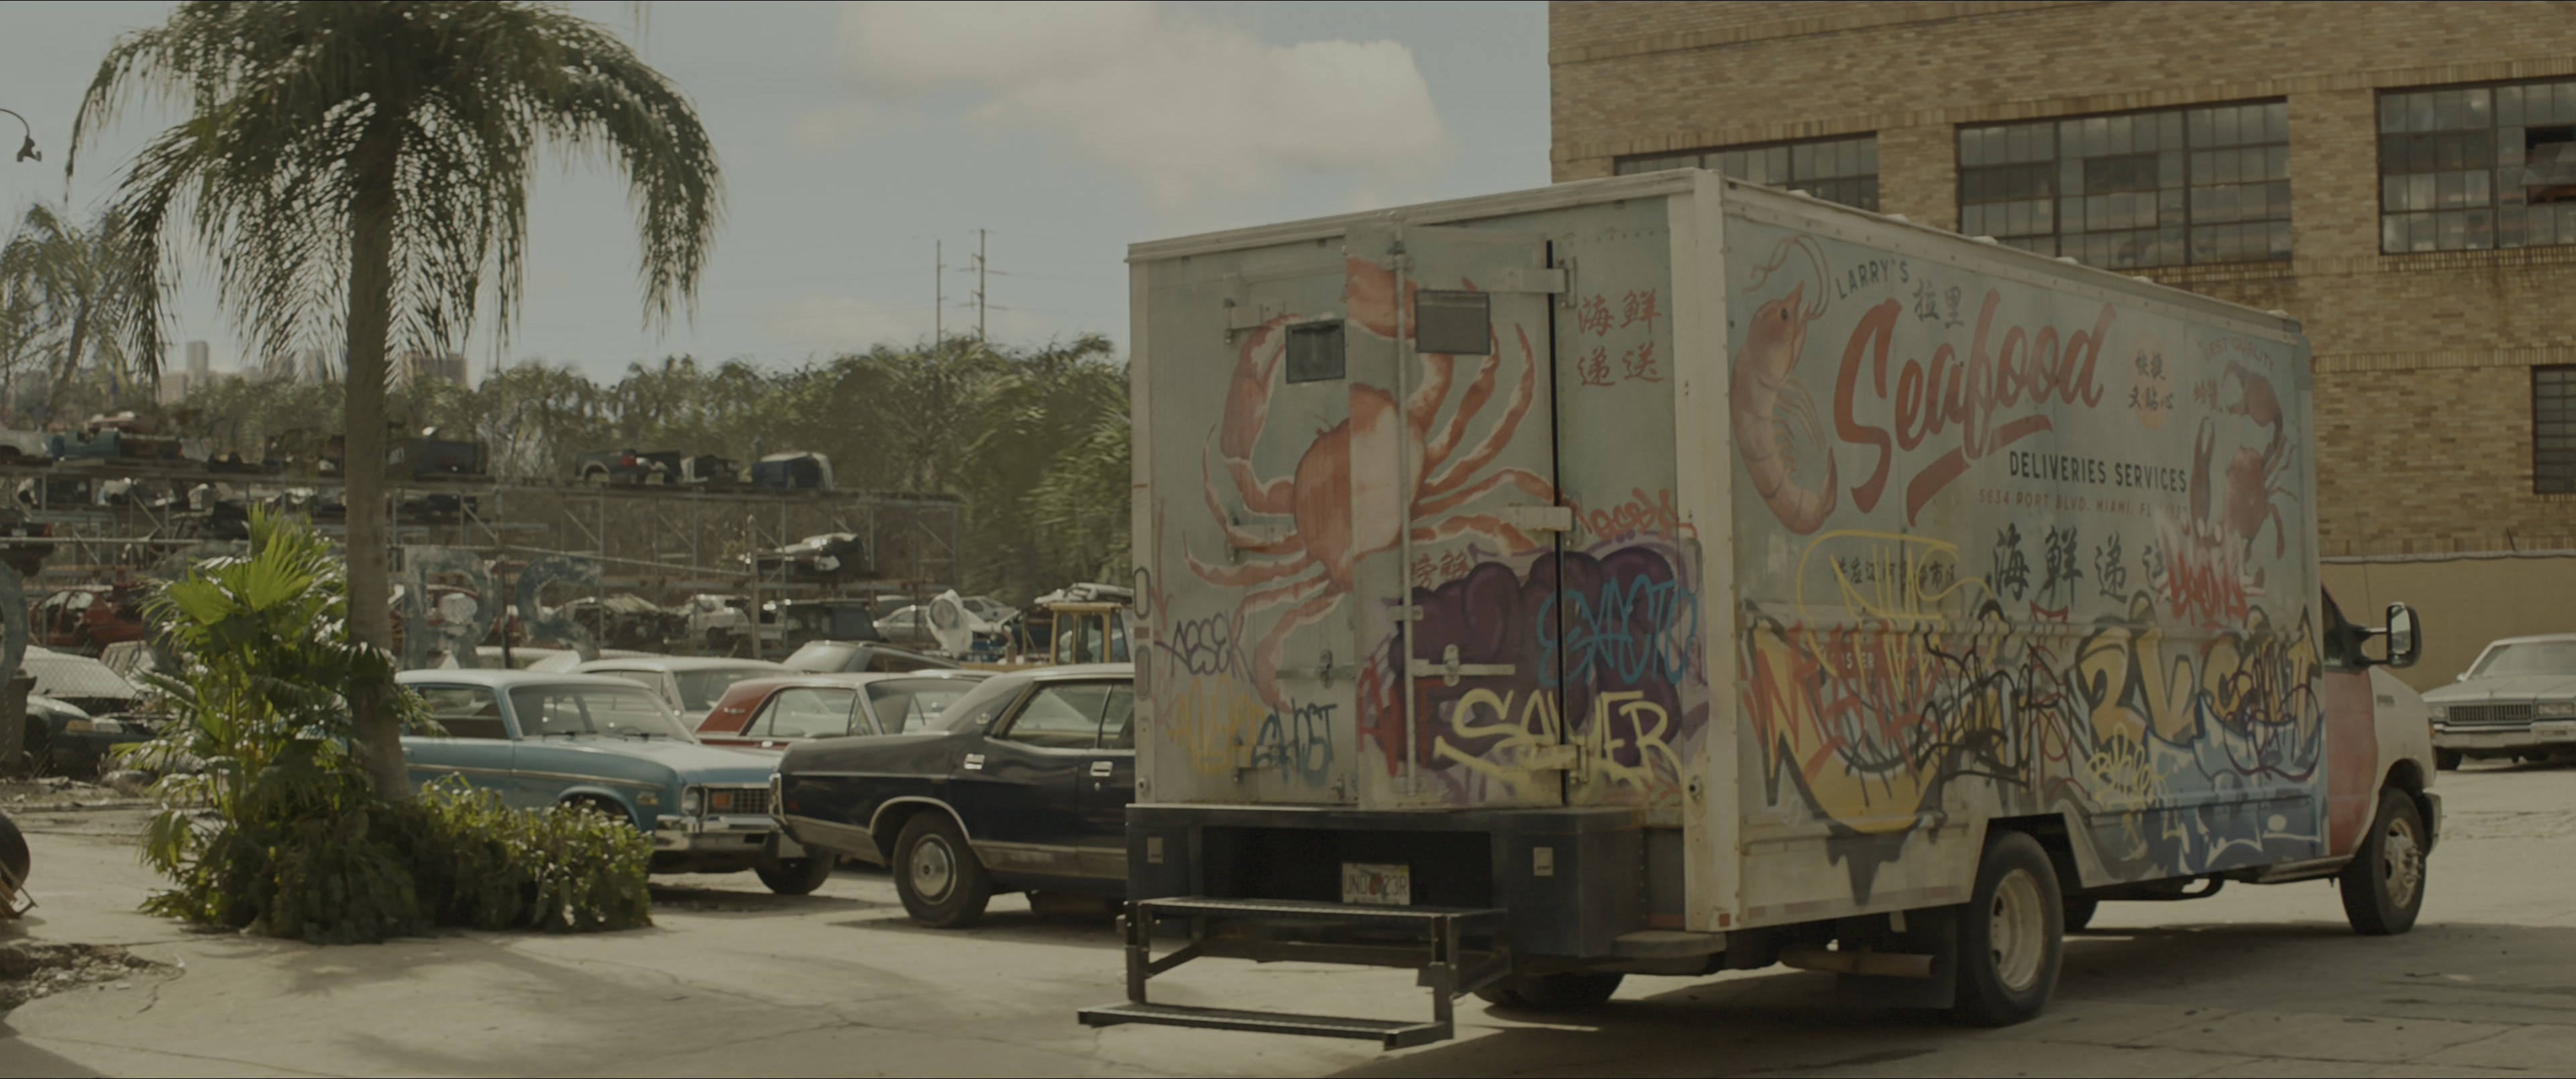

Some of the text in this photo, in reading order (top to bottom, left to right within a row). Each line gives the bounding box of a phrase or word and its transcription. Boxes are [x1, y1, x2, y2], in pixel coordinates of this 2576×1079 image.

[1835, 258, 1909, 300] LARRY'S
[1911, 277, 1965, 329] 拉里
[1833, 287, 2118, 514] Seafood
[2009, 450, 2188, 493] DELIVERIES SERVICES
[2016, 491, 2049, 508] PORT
